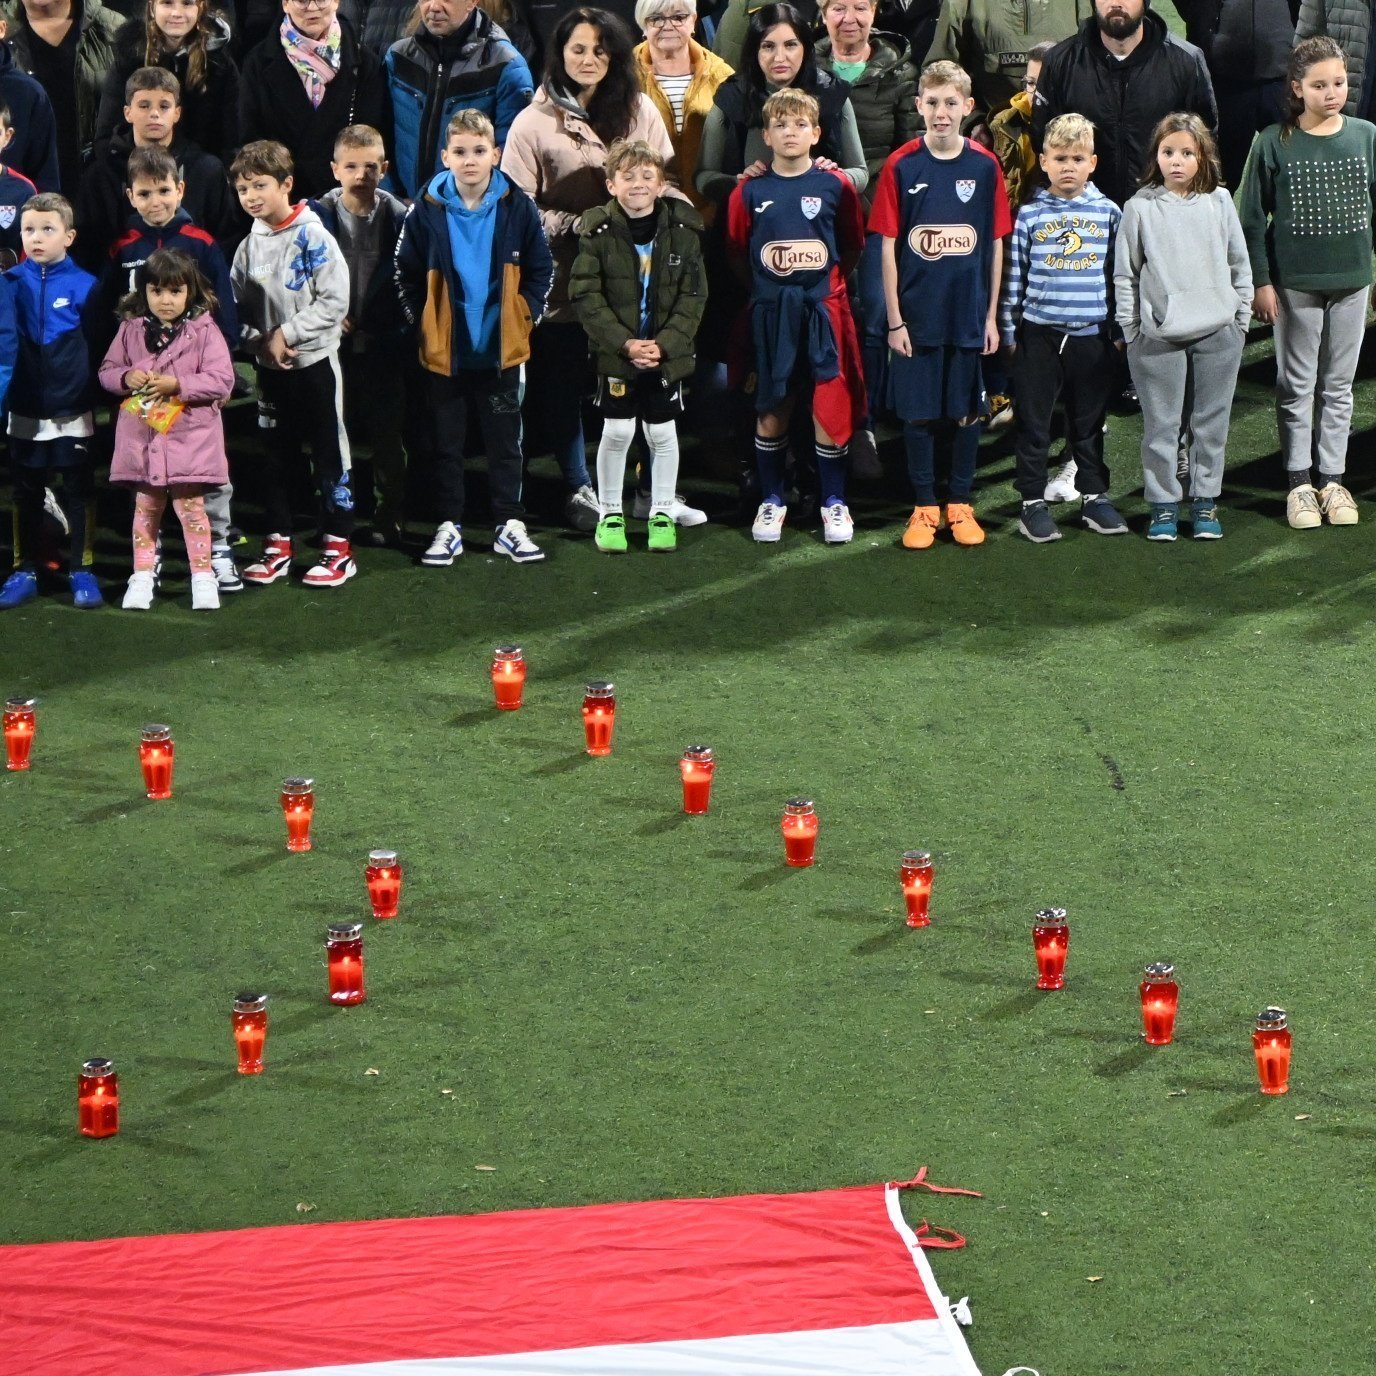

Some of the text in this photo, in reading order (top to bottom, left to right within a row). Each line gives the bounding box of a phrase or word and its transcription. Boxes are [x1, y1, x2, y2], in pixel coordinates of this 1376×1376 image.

[918, 228, 971, 257] Tarsa
[1034, 214, 1068, 243] WOLF
[770, 245, 823, 273] Tarsa
[1043, 252, 1098, 272] MOTORS
